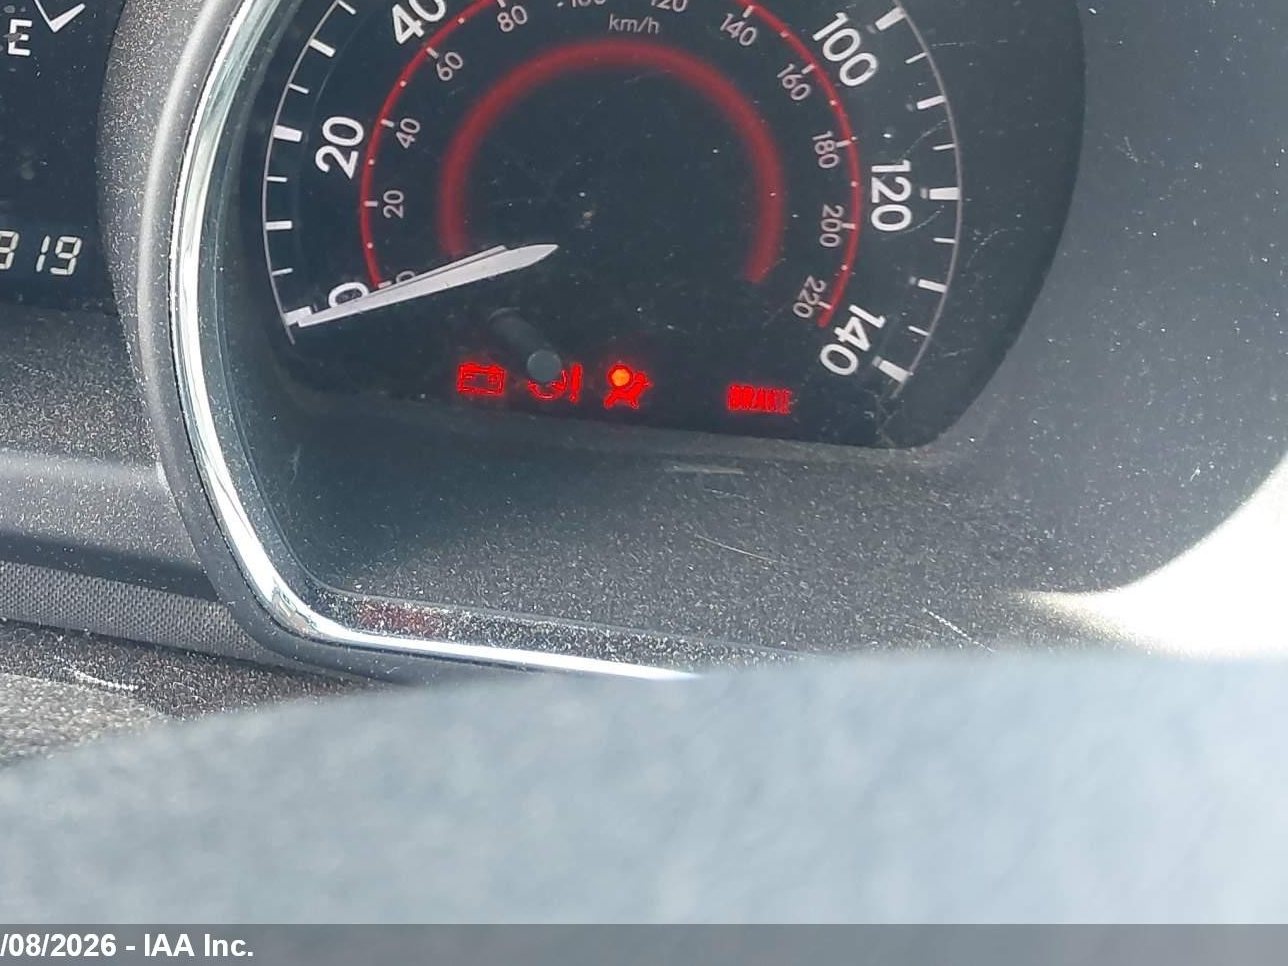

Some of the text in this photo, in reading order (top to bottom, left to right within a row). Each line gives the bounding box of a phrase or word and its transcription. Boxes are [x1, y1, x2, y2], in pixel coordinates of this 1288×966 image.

[497, 3, 529, 33] 80
[608, 13, 661, 34] km/h
[718, 13, 758, 47] 140
[7, 19, 32, 57] E
[811, 10, 879, 88] 100
[435, 50, 464, 82] 60
[776, 63, 811, 102] 160
[315, 115, 365, 179] 20
[397, 117, 421, 149] 40
[811, 130, 839, 170] 180
[383, 190, 405, 219] 20
[870, 160, 912, 233] 120
[820, 204, 843, 249] 200
[792, 276, 828, 319] 220
[819, 302, 885, 376] 140
